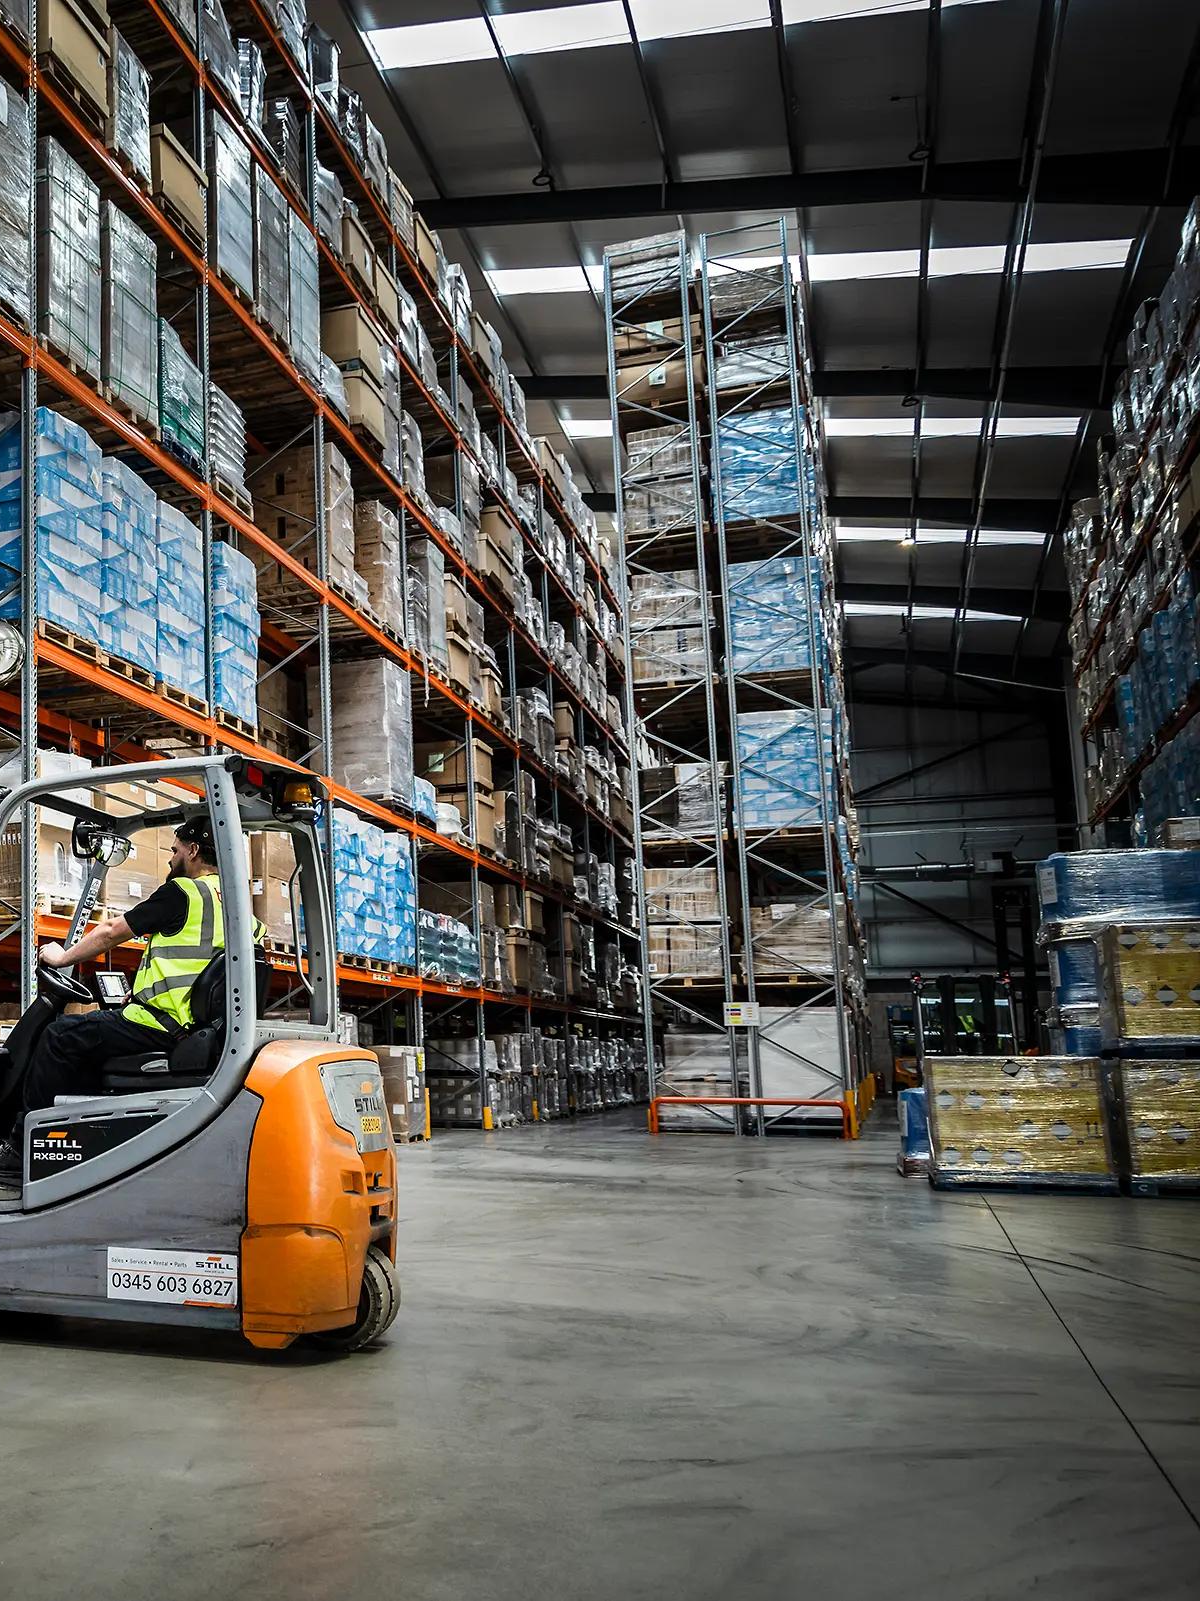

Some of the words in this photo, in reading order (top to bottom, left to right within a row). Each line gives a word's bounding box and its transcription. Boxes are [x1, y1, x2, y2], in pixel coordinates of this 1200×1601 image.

[354, 1097, 382, 1112] STILL
[34, 1140, 82, 1148] STILL
[34, 1152, 82, 1161] RX20-20
[196, 1262, 234, 1270] STILL
[112, 1272, 152, 1290] 0345
[156, 1276, 187, 1293] 603
[192, 1279, 233, 1296] 6827
